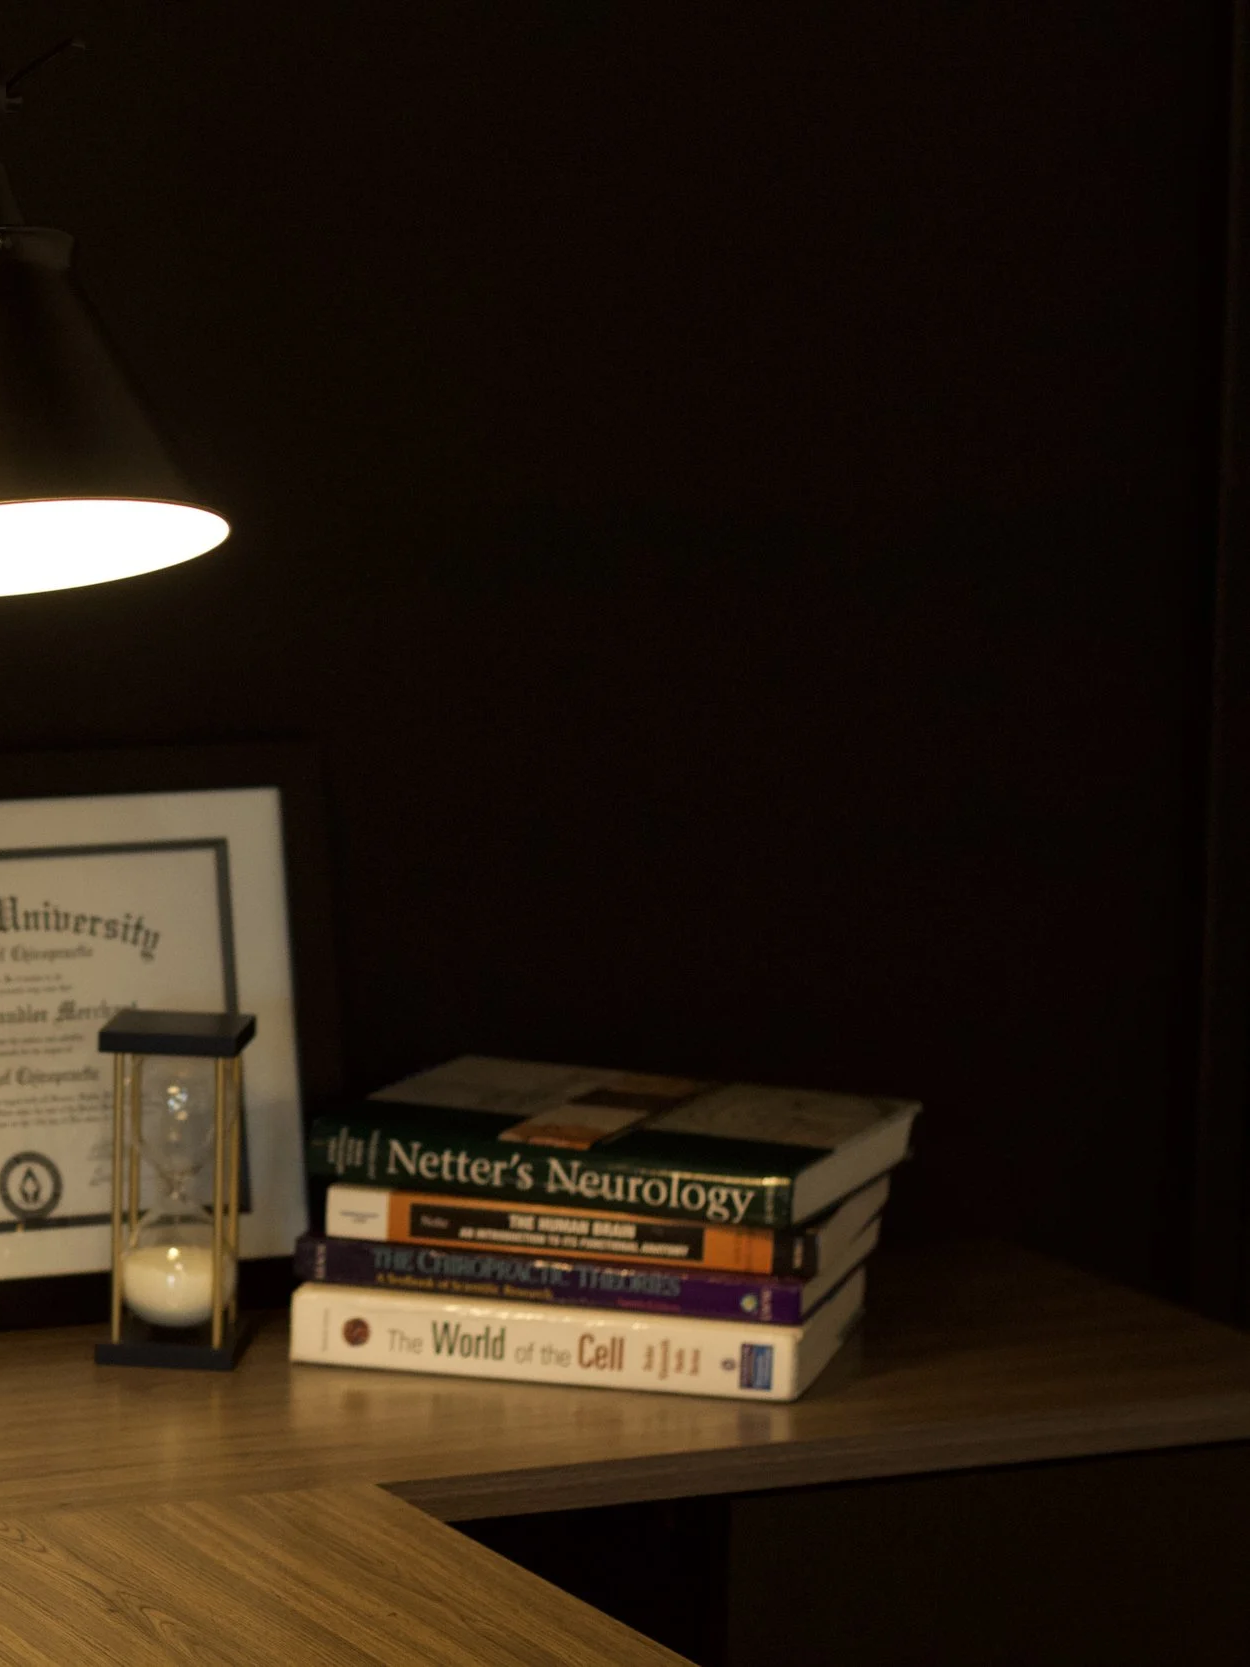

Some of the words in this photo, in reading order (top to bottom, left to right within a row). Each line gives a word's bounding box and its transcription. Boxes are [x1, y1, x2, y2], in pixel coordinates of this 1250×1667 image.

[385, 1137, 535, 1191] Netter's
[545, 1156, 756, 1224] Neurology
[509, 1214, 536, 1232] THE
[537, 1216, 590, 1236] HUMAN
[591, 1220, 637, 1240] BRAIN
[373, 1246, 415, 1271] THE
[417, 1249, 572, 1287] CHIROPRACTIC
[577, 1265, 682, 1297] THEORIES
[387, 1328, 424, 1353] The
[432, 1320, 507, 1361] World
[514, 1343, 535, 1364] of
[540, 1344, 572, 1367] the
[578, 1332, 626, 1373] Cell
